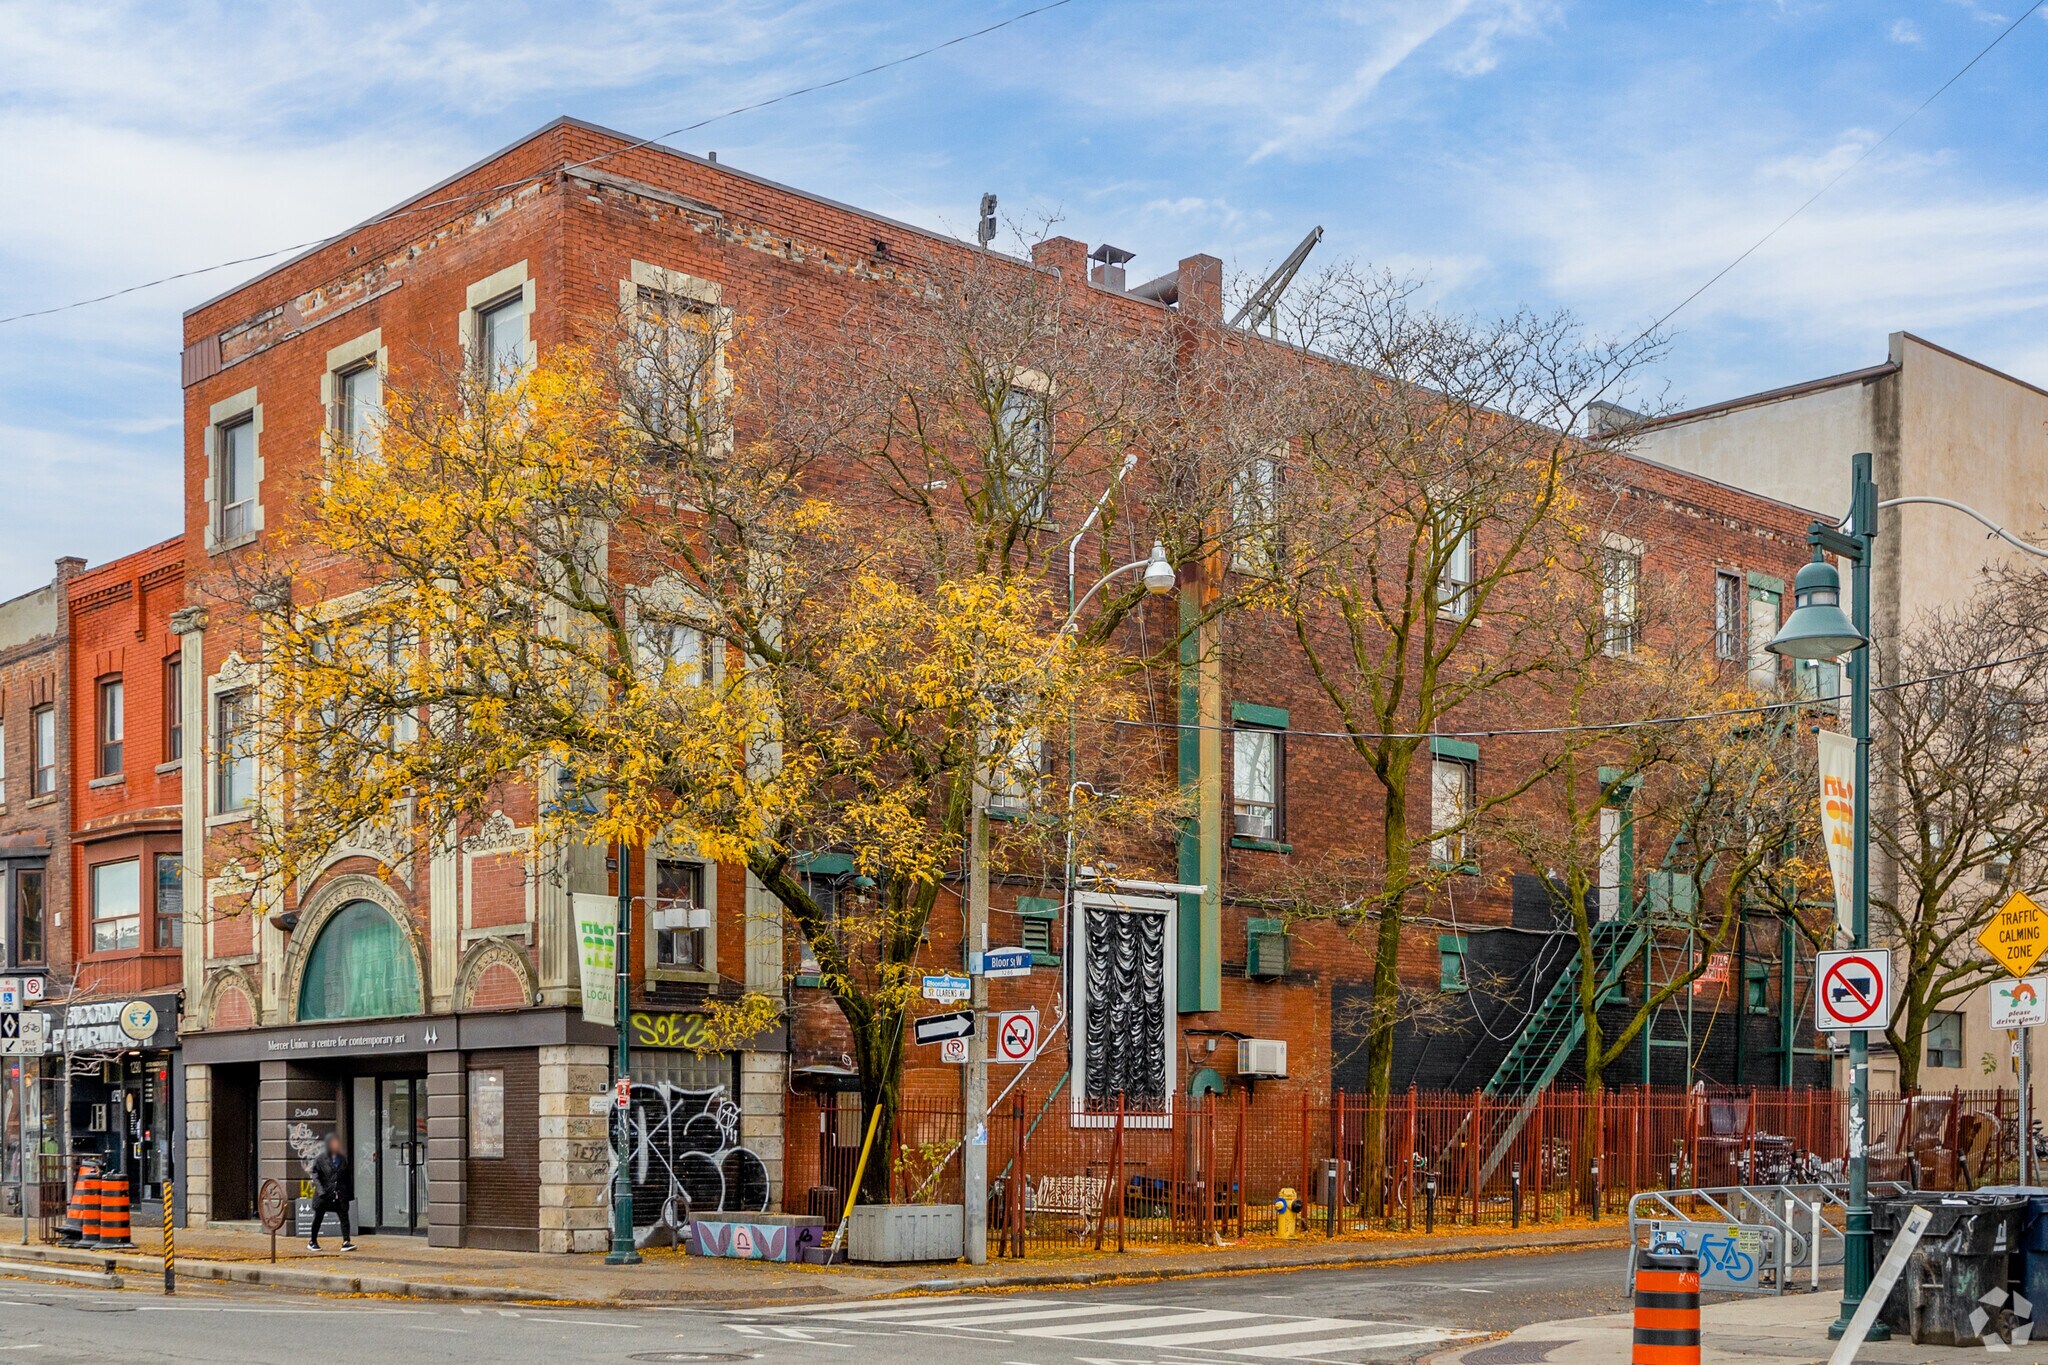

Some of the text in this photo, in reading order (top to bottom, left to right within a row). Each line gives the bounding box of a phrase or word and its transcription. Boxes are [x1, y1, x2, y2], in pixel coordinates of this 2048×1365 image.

[2001, 909, 2039, 926] TRAFFIC
[1999, 926, 2040, 943] CALMING
[2007, 944, 2033, 960] ZONE
[991, 956, 1009, 968] Bloor
[1016, 955, 1023, 966] W
[950, 981, 967, 989] Village
[586, 989, 612, 1003] LOCAL
[936, 989, 957, 997] CLARENS
[2018, 1015, 2041, 1024] slowly
[268, 1034, 405, 1051] Mercer Union a centre for contemporary art
